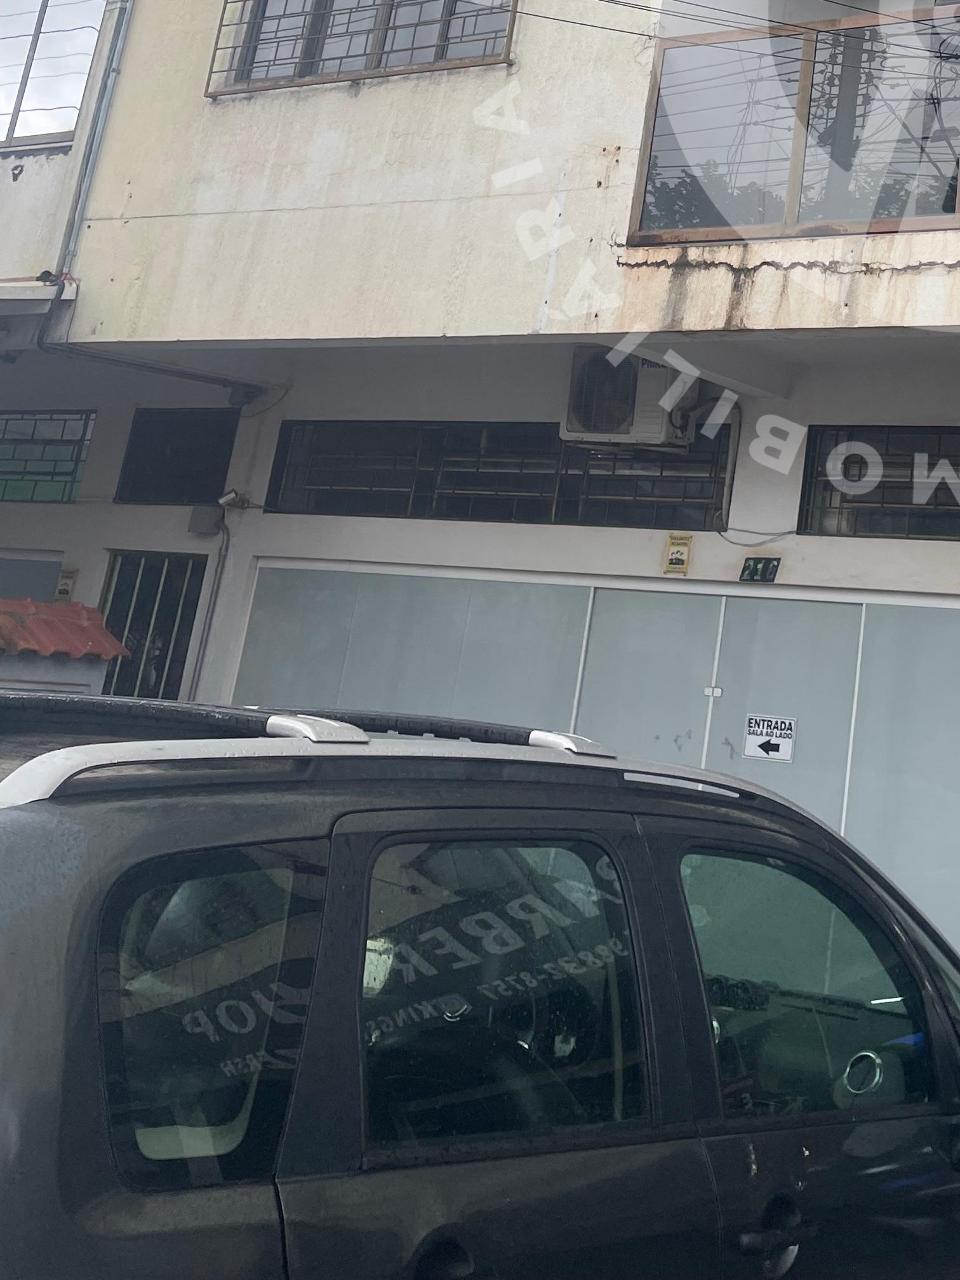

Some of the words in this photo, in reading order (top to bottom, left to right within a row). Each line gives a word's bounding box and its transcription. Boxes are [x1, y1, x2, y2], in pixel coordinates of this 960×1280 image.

[748, 717, 793, 732] ENTRADA
[747, 729, 763, 737] SALA
[765, 730, 774, 738] AO
[775, 731, 793, 740] LADO
